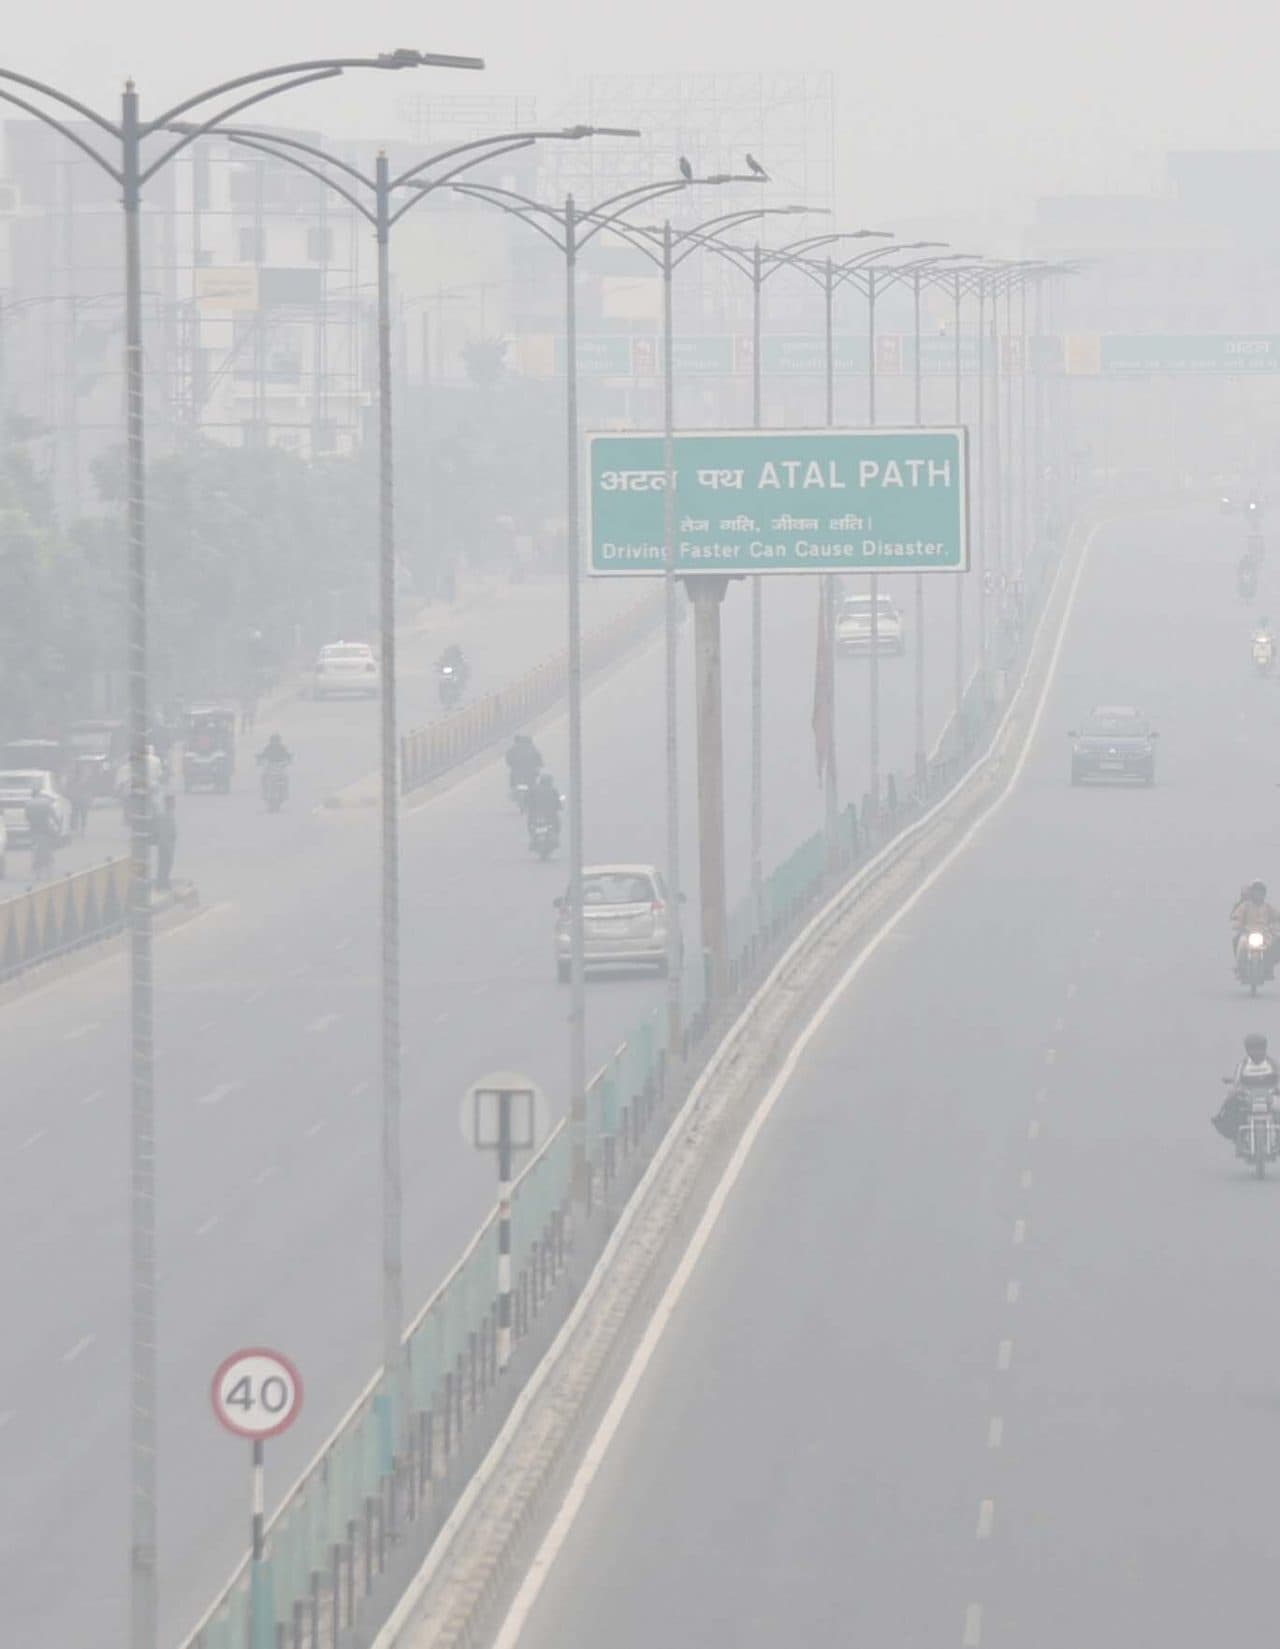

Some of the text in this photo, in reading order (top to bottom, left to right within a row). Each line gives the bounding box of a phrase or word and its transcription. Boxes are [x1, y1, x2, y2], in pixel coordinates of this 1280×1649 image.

[697, 469, 744, 489] पथ
[758, 459, 950, 489] ATAL PATH
[680, 542, 740, 558] Faster
[750, 542, 786, 557] Can
[795, 541, 853, 557] Cause
[863, 540, 949, 556] Disaster.
[226, 1376, 287, 1412] 40
